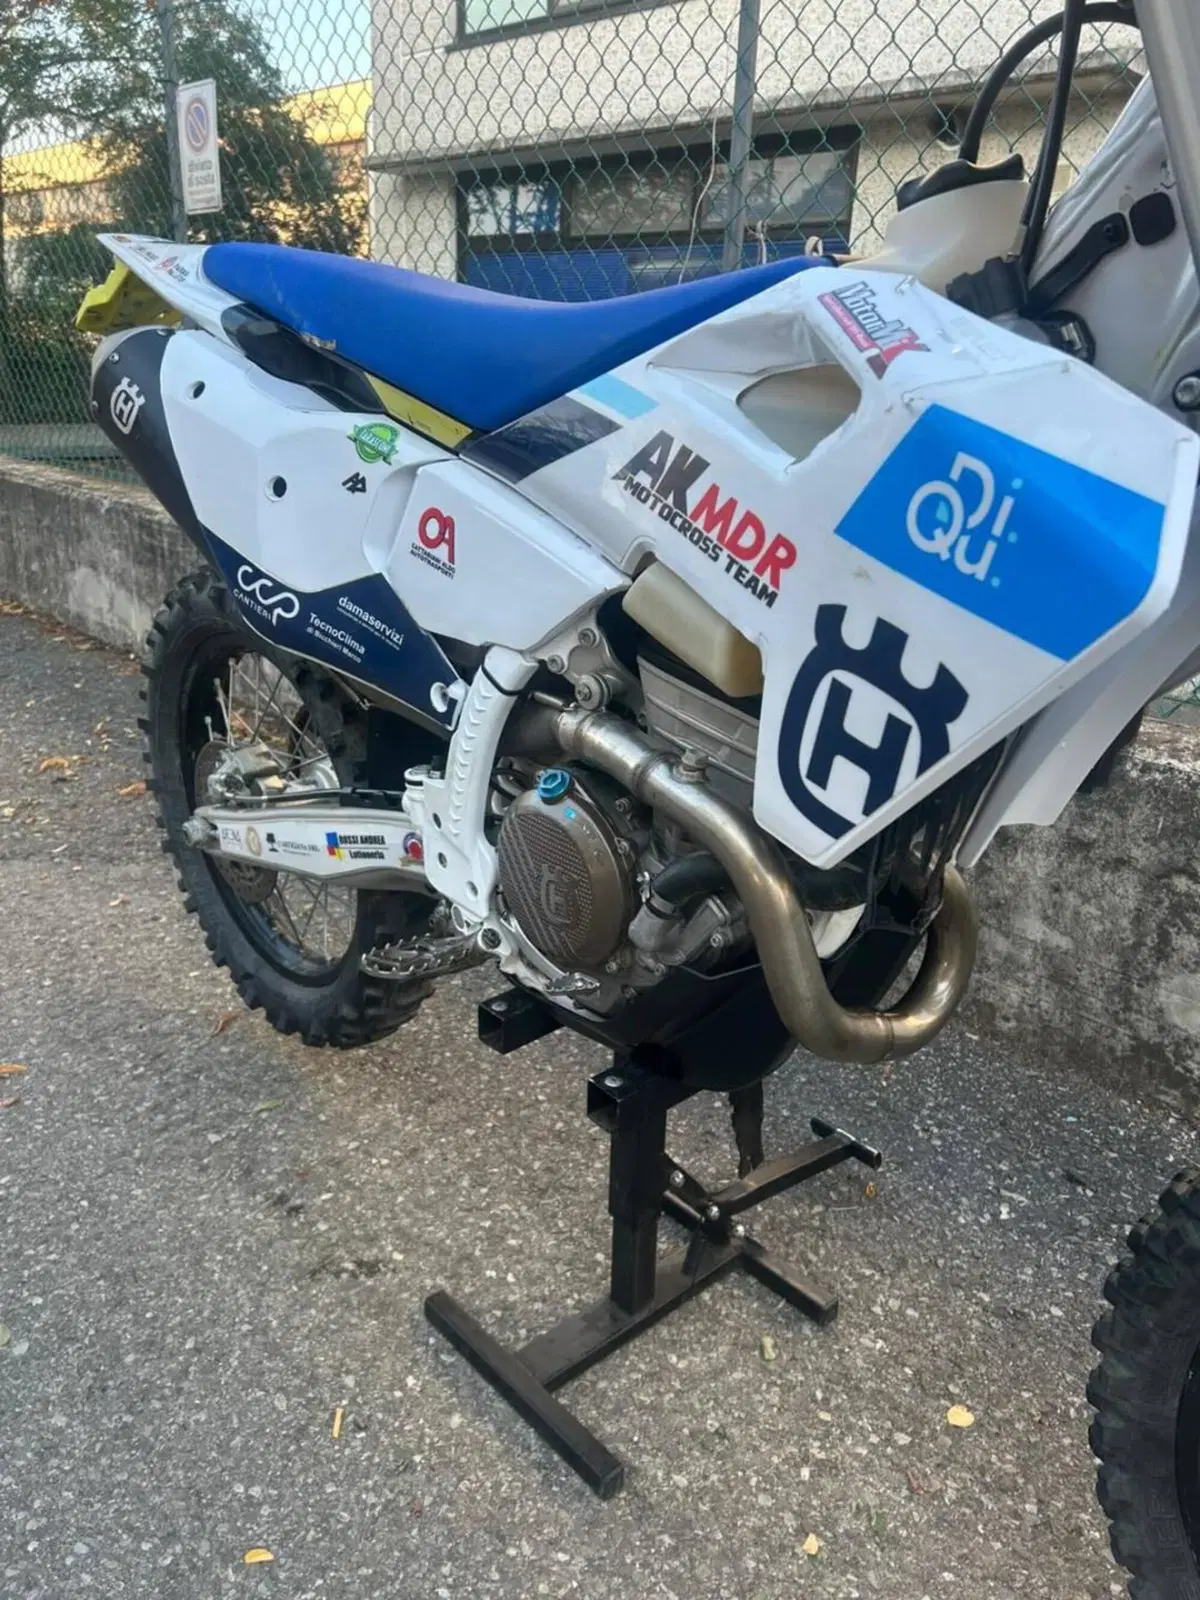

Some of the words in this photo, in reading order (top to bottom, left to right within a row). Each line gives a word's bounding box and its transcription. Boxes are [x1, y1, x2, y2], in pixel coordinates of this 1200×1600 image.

[623, 475, 723, 562] MOTOCROSS
[724, 553, 778, 608] TEAM
[233, 588, 271, 620] CANTIERI
[338, 596, 405, 646] damaservizi
[309, 612, 366, 655] TecnoClima
[360, 834, 386, 846] ANDREA
